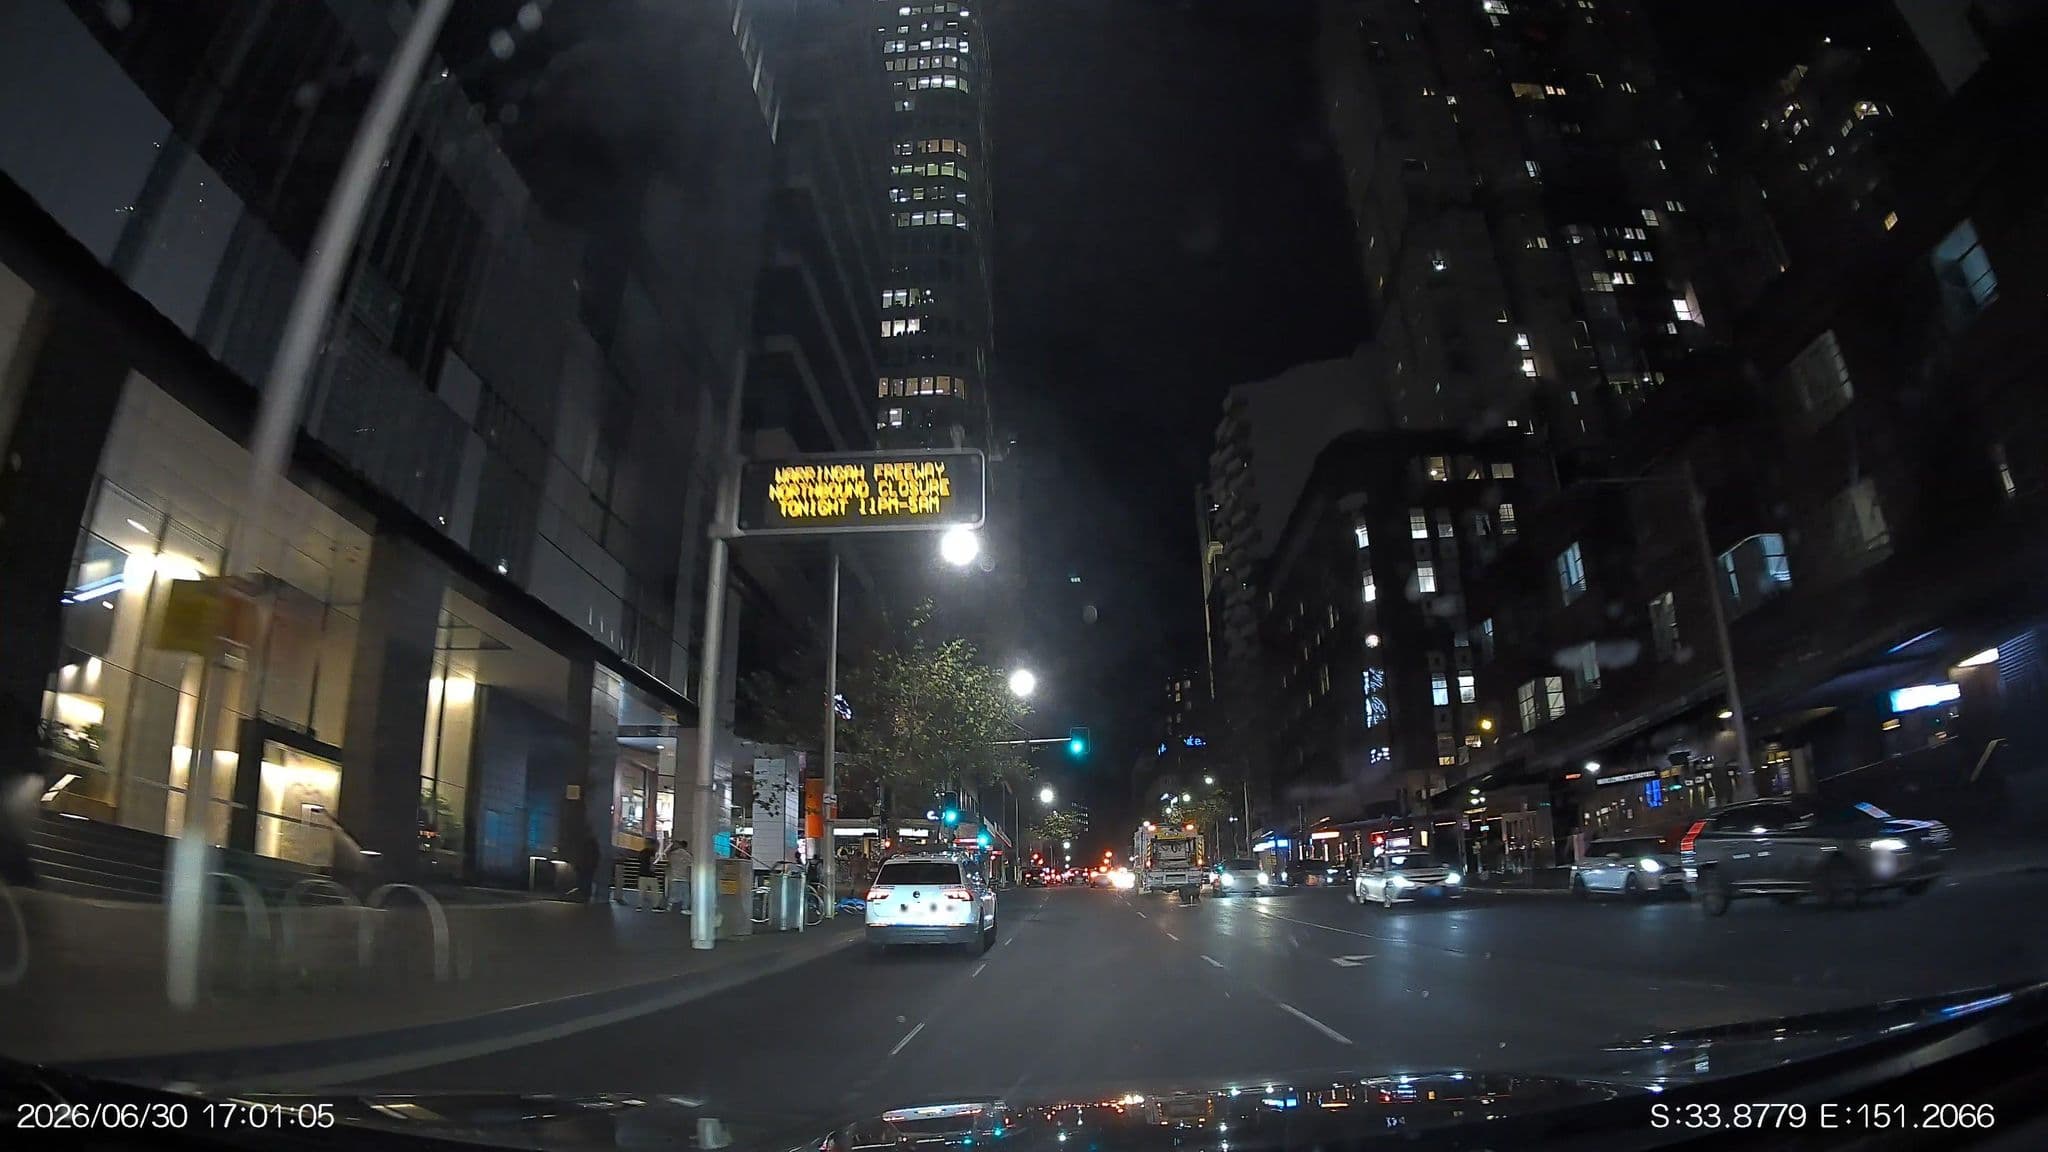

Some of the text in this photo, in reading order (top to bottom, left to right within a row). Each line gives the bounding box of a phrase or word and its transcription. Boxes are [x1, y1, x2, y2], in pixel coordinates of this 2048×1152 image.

[873, 462, 945, 481] FREEWAY
[769, 478, 950, 502] NORTHBOUND CLOSURE
[780, 496, 940, 518] TONIGHT 11PM-5AM
